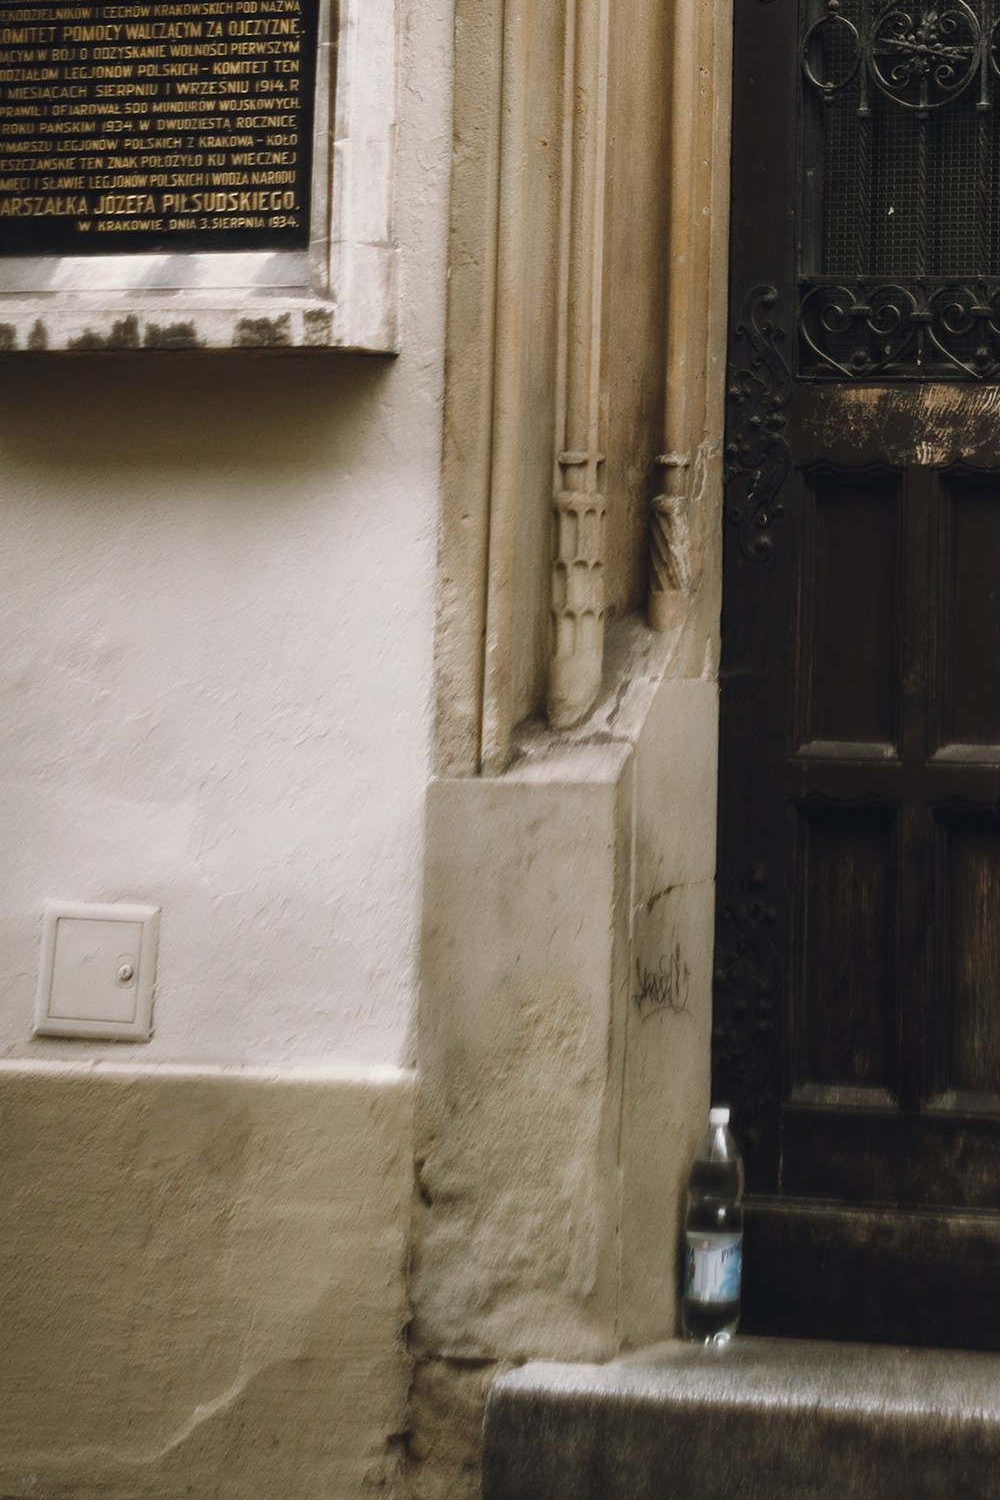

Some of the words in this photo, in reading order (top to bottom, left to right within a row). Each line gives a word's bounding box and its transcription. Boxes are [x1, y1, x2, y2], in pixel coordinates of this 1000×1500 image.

[0, 3, 92, 25] ĘKODZIELNIKÓW
[103, 1, 151, 19] CECHÓW
[153, 2, 234, 17] KRAKOWSKICH
[236, 1, 259, 14] POD
[260, 0, 303, 15] NAZWĄ
[0, 26, 57, 44] OMITET
[63, 24, 123, 43] POMOCY
[125, 21, 202, 43] WALCZĄCYM
[206, 21, 223, 38] ZA
[228, 18, 306, 39] OJCZYZNĘ.
[37, 49, 48, 62] W
[52, 45, 76, 62] BÓJ
[80, 47, 88, 61] O
[93, 44, 167, 60] ODZYSKANIE
[170, 40, 228, 57] WOLNOŚCI
[230, 40, 300, 55] PIERWSZYM
[64, 61, 133, 80] LEGJONÓW
[137, 63, 199, 78] POLSKICH
[213, 60, 269, 75] KOMITET
[274, 59, 299, 73] TEN
[8, 85, 87, 102] MIESIĄCACH
[95, 83, 159, 98] SIERPNIU
[176, 76, 249, 94] WRZEŚNIU
[0, 105, 41, 117] PRAWIŁ
[52, 103, 122, 116] OFIAROWAŁ
[124, 102, 149, 115] 500
[152, 97, 216, 113] MUNDURÓW
[219, 97, 302, 112] WOJSKOWYCH.
[2, 123, 35, 135] ROKU
[39, 118, 96, 134] PAŃSKIM
[139, 119, 150, 132] W
[157, 118, 232, 132] DWUDZIESTĄ
[236, 115, 298, 130] ROCZNICĘ
[0, 140, 52, 153] YMARSZU
[56, 135, 119, 152] LEGJONÓW
[124, 137, 182, 151] POLSKICH
[187, 136, 195, 148] Z
[198, 135, 254, 149] KRAKOWA
[266, 133, 298, 146] KOŁO
[0, 155, 77, 171] ESZCZAŃSKIE
[80, 157, 103, 170] TEN
[107, 156, 138, 169] ZNAK
[141, 151, 203, 168] POŁOŻYŁO
[207, 153, 226, 166] KU
[230, 151, 297, 166] WIECZNEJ
[0, 177, 30, 194] MIĘCI
[41, 175, 86, 190] SŁAWIE
[89, 171, 148, 189] LEGJONÓW
[150, 173, 203, 187] POLSKICH
[211, 171, 250, 186] WODZA
[251, 170, 297, 185] NARODU
[0, 195, 89, 217] ARSZAŁKA
[94, 190, 156, 215] JÓZEFA
[162, 190, 300, 213] PIŁSUDSKIEGO.
[79, 220, 92, 232] W
[169, 218, 197, 230] DNIA
[268, 215, 299, 228] 1934.
